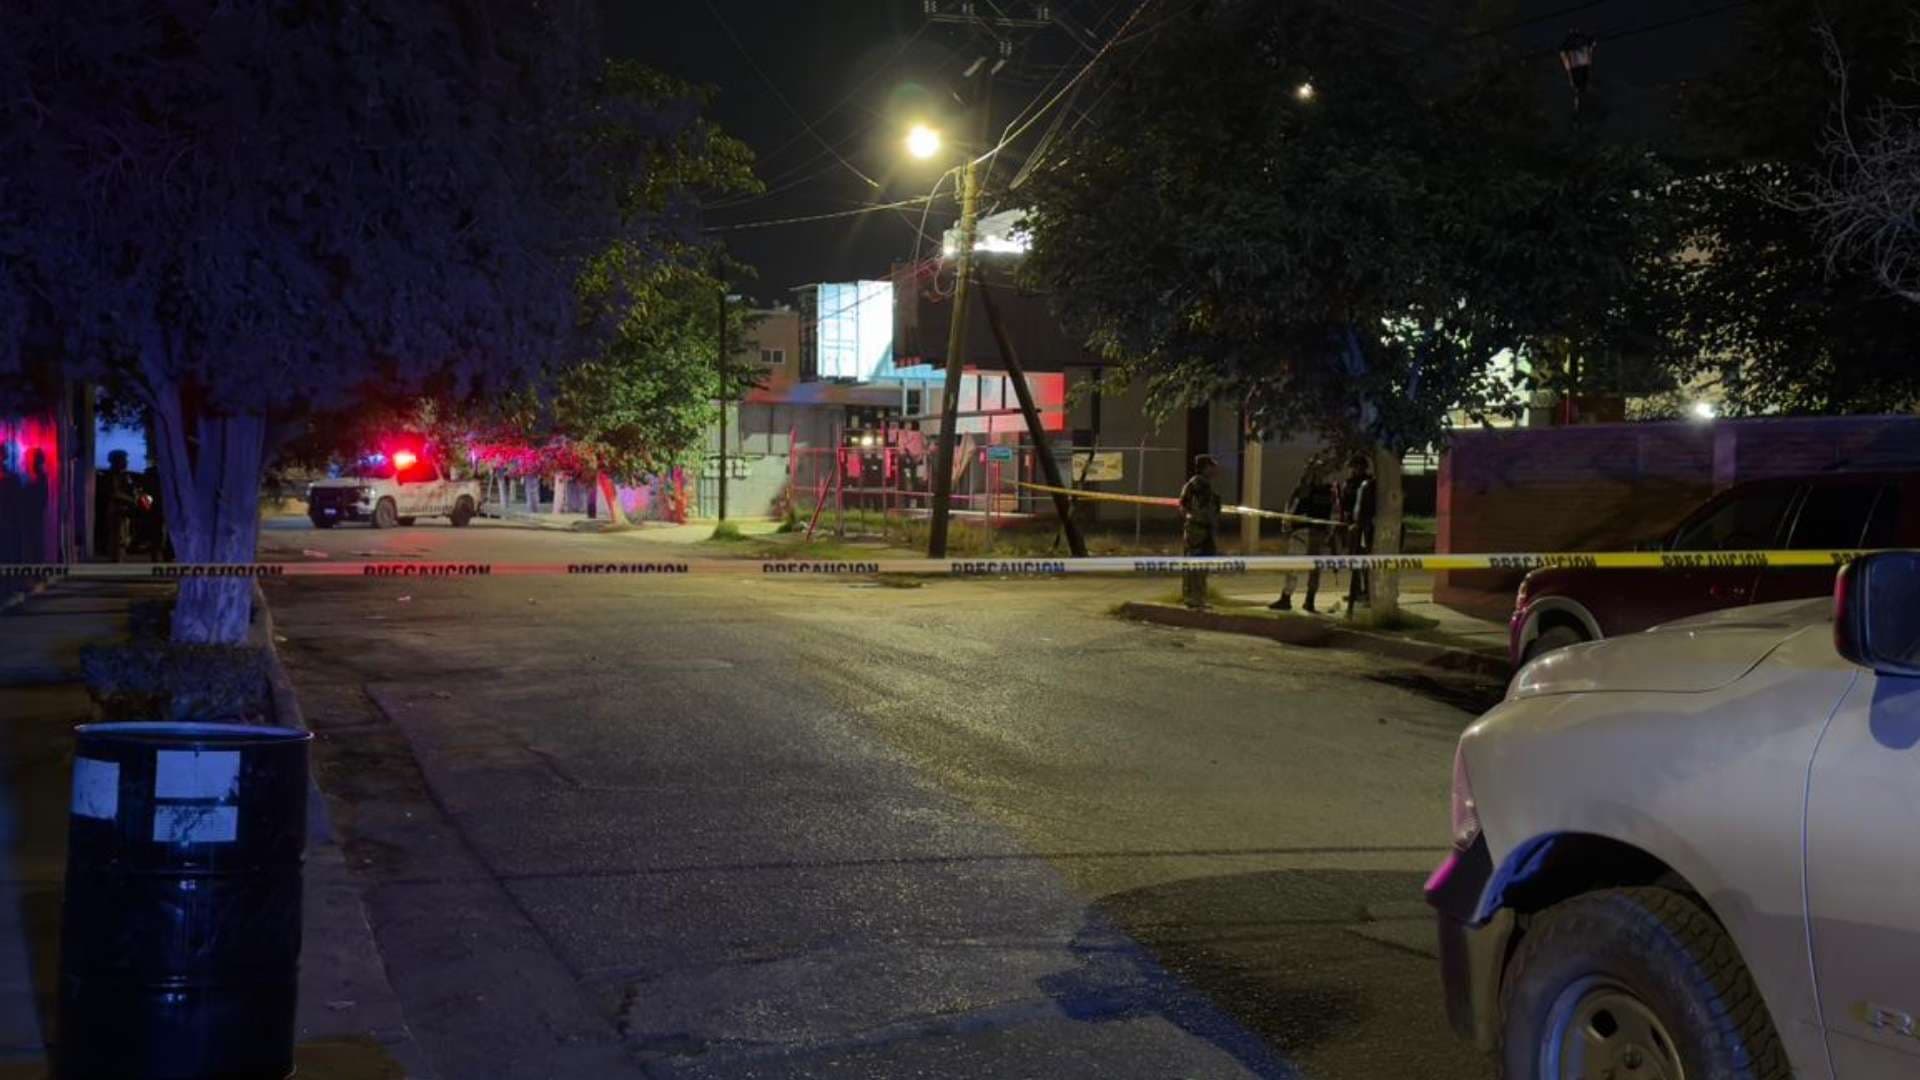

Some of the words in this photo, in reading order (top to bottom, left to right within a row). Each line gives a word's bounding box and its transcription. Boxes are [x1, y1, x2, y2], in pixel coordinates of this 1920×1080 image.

[151, 565, 285, 577] PRECAUCION
[363, 564, 491, 576] PRECAUCION
[567, 563, 690, 574] PRECAUCION
[763, 563, 879, 573] PRECAUCION
[951, 561, 1067, 574] PRECAUCION
[1134, 561, 1246, 573] PRECAUCION
[1313, 559, 1424, 571] PRECAUCION
[1488, 556, 1596, 570] PRECAUCION
[1660, 553, 1768, 567] PRECAUCION
